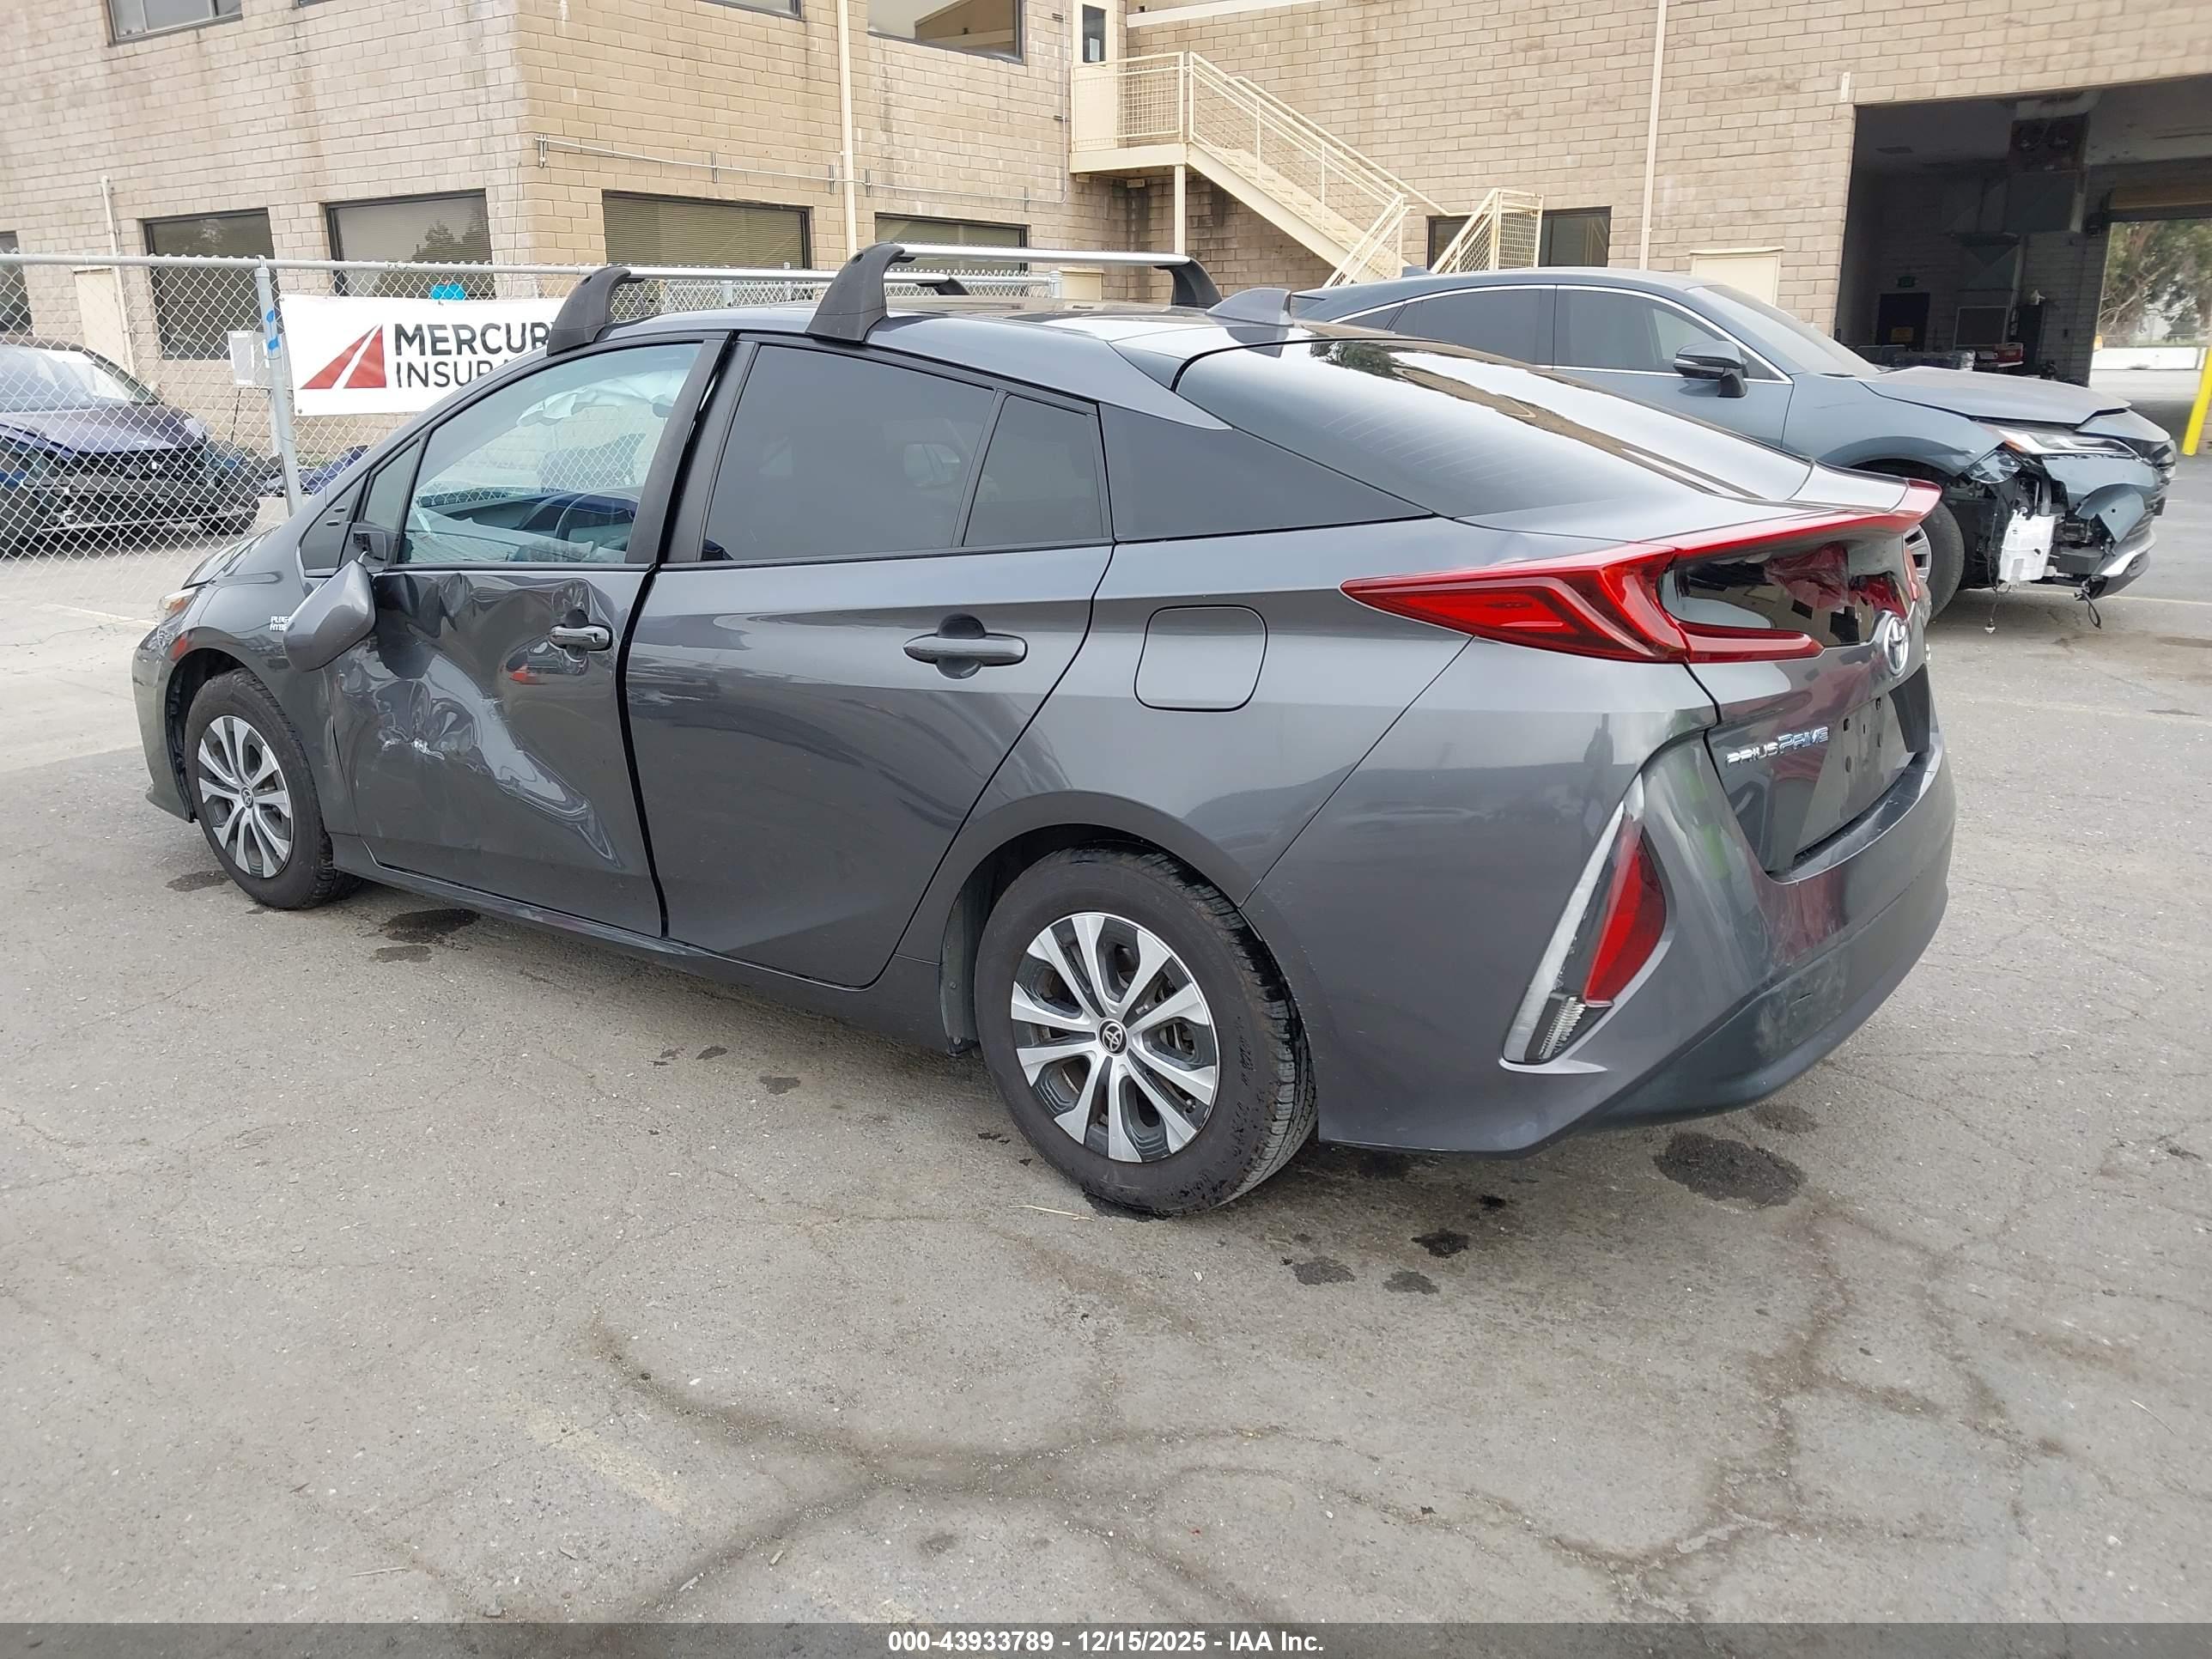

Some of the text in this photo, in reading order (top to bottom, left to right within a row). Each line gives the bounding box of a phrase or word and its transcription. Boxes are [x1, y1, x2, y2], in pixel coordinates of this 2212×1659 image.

[394, 322, 554, 356] MERCUR
[396, 359, 509, 388] INSUR
[269, 623, 286, 632] HYB
